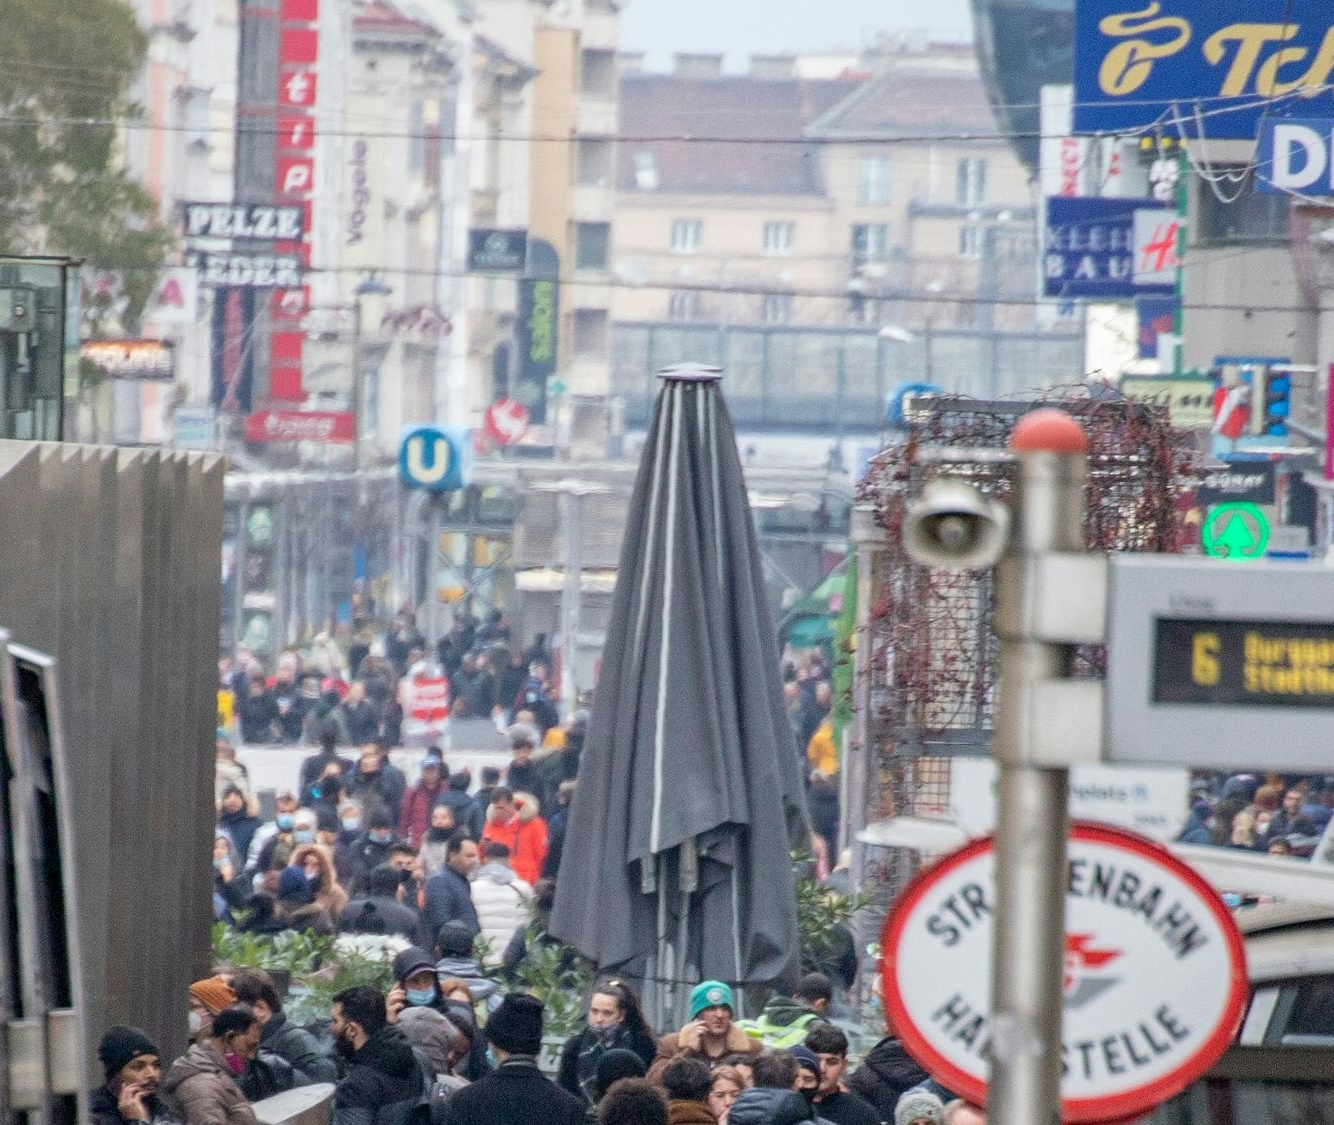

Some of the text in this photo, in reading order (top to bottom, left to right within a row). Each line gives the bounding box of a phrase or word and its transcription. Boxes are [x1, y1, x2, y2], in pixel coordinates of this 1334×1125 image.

[187, 205, 301, 238] PELZE
[406, 436, 451, 483] U
[1192, 632, 1220, 687] 6
